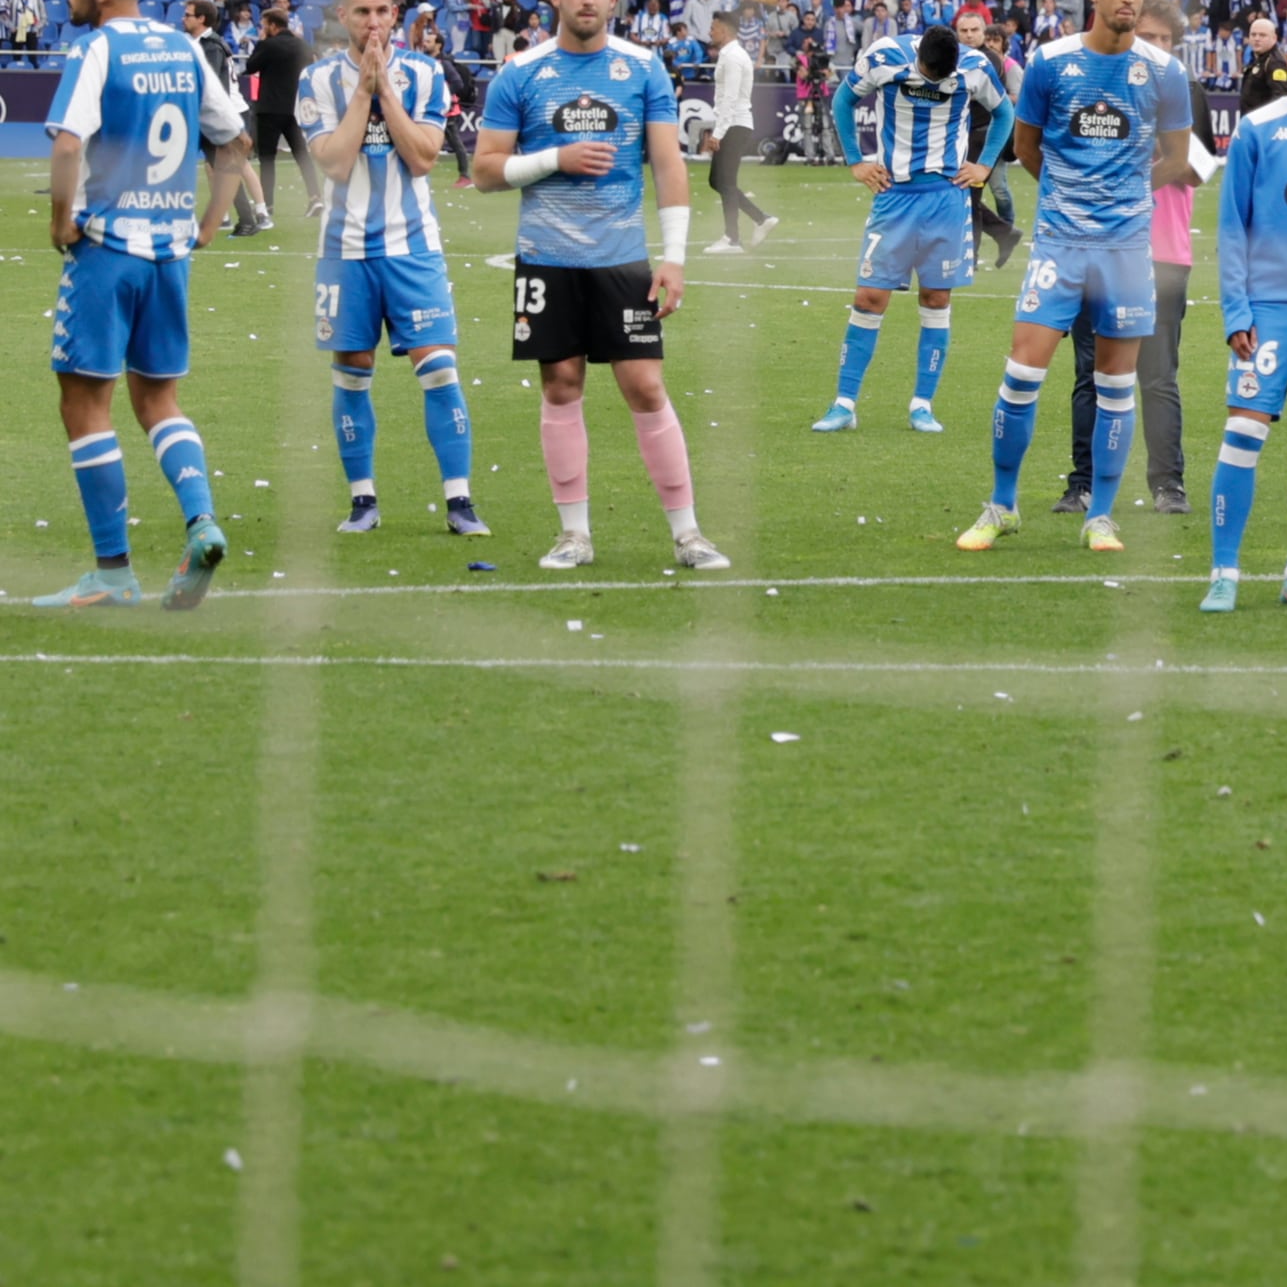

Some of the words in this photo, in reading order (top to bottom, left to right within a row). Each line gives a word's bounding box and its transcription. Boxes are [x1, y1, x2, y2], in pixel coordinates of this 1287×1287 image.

[132, 71, 196, 94] QUILES
[562, 107, 608, 120] Estrella
[564, 119, 606, 132] Galicia
[1079, 113, 1121, 127] Estrella
[146, 103, 188, 185] 9
[1079, 124, 1119, 138] Galicia
[864, 233, 882, 260] 7
[1029, 260, 1057, 289] 16
[315, 283, 340, 317] 21
[516, 277, 546, 314] 13
[1236, 340, 1279, 376] 6
